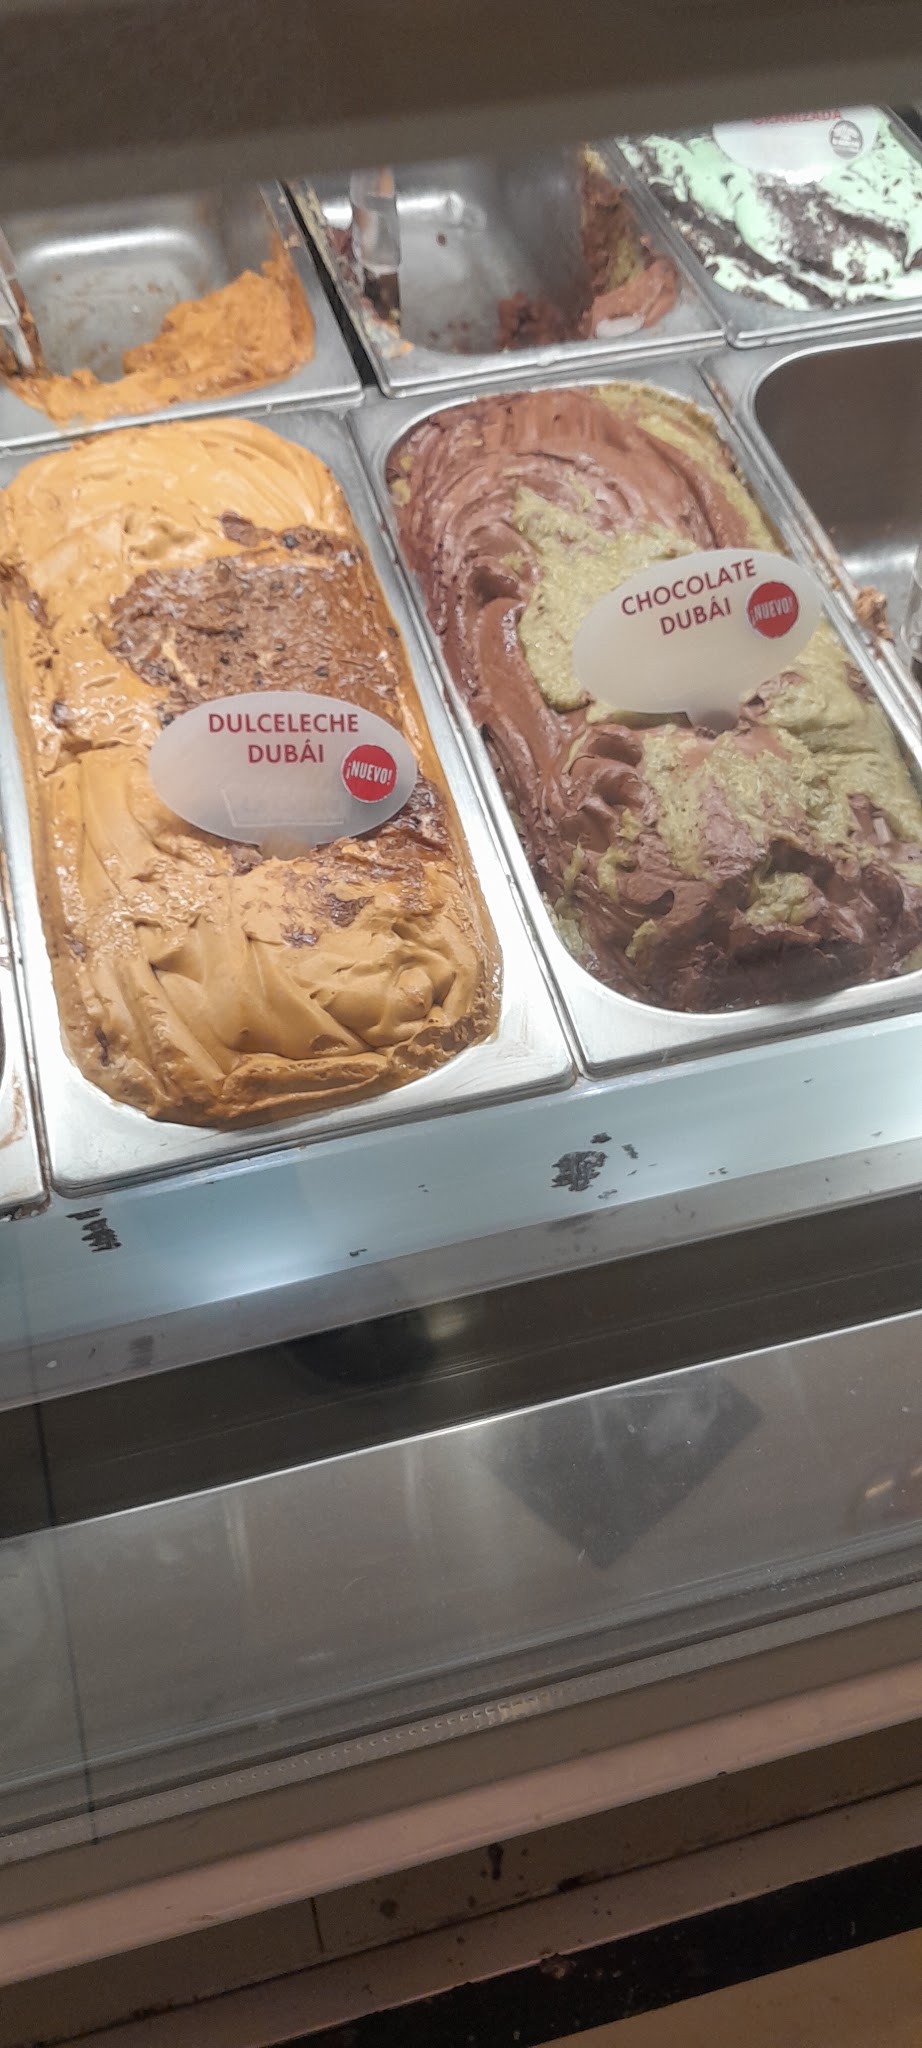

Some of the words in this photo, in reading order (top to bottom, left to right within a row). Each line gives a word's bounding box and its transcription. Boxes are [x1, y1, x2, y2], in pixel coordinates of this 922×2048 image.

[621, 559, 757, 616] CHOCOLATE
[659, 596, 731, 635] DUBÁI
[750, 596, 793, 627] ¡NUEVO!
[208, 713, 359, 733] DULCELECHE
[248, 739, 324, 763] DUBÁI
[346, 760, 393, 786] ¡NUEVO!
